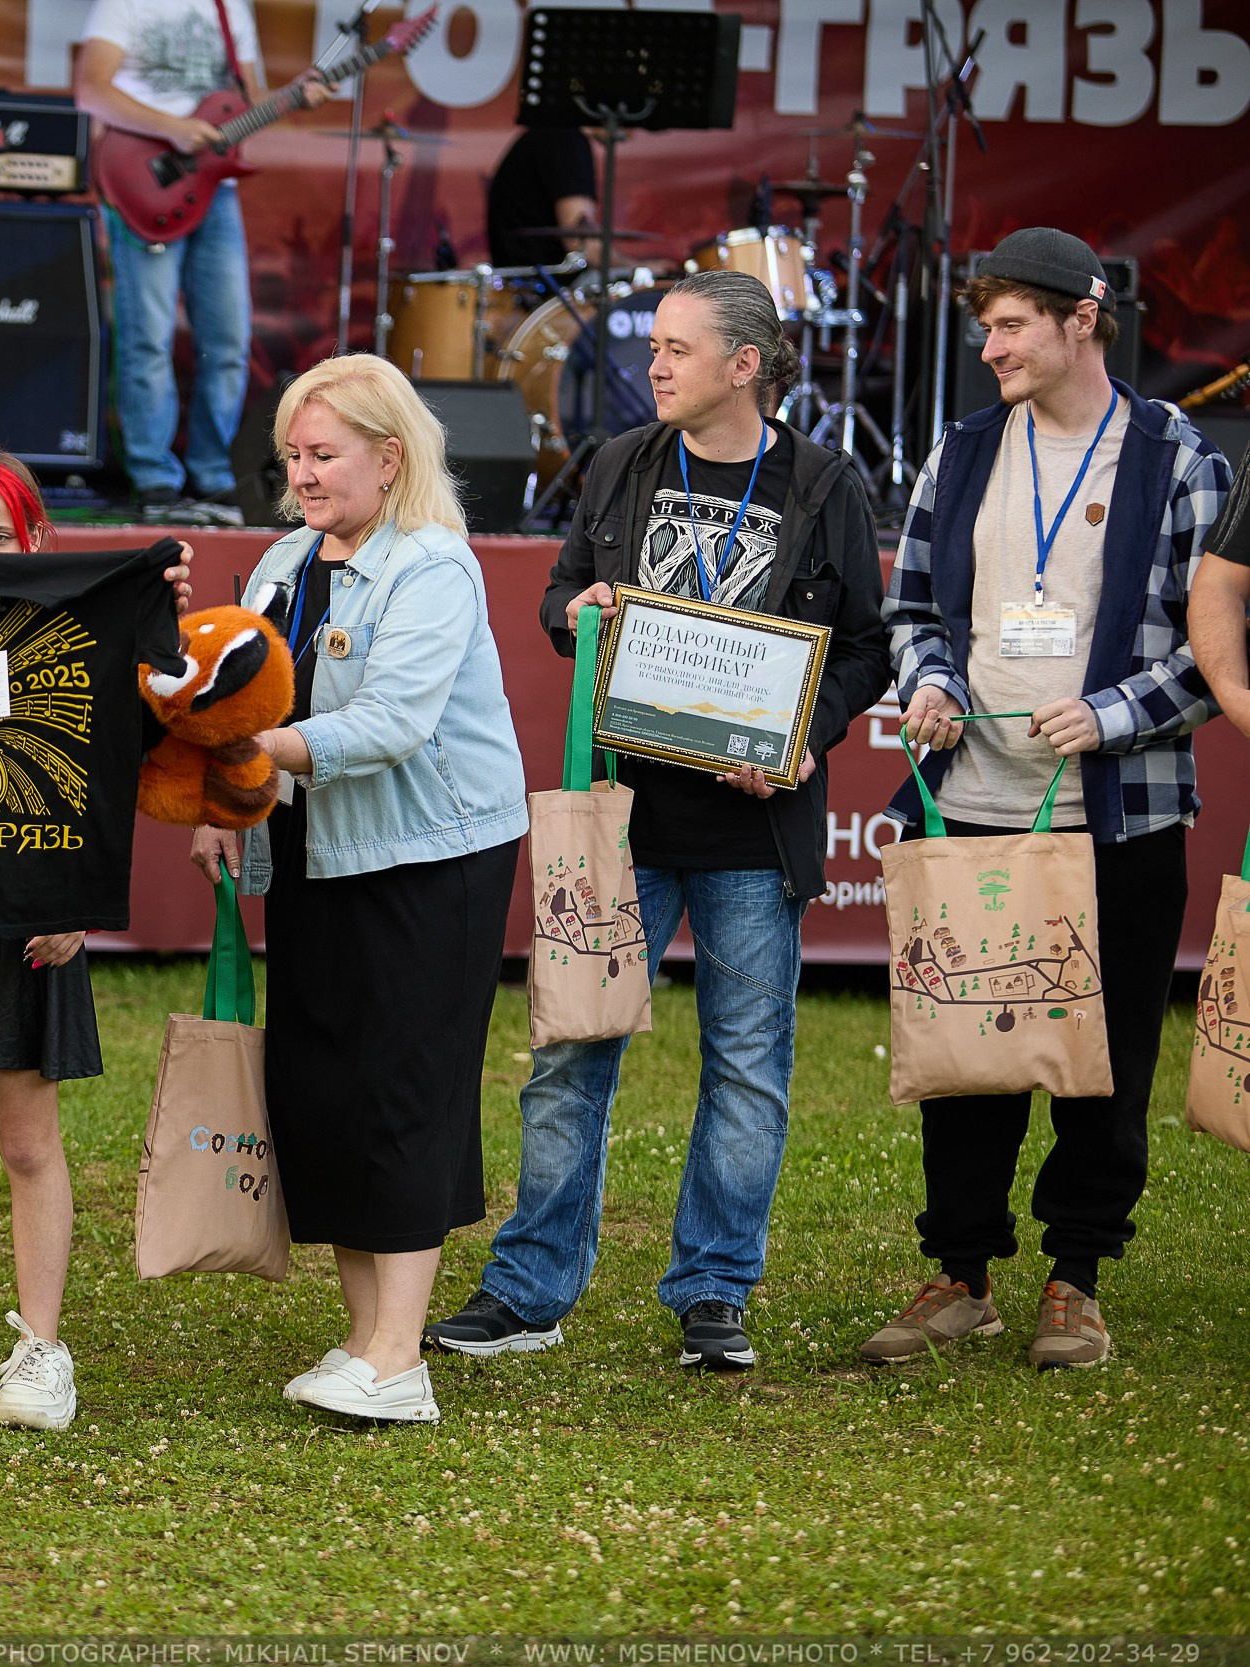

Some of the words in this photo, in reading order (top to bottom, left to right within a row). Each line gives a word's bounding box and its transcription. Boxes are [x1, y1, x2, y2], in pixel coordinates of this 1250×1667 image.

[627, 639, 754, 678] СЕРТИФИКАТ
[631, 619, 768, 661] ПОДАРОЧНЫЙ
[26, 661, 90, 690] 2025
